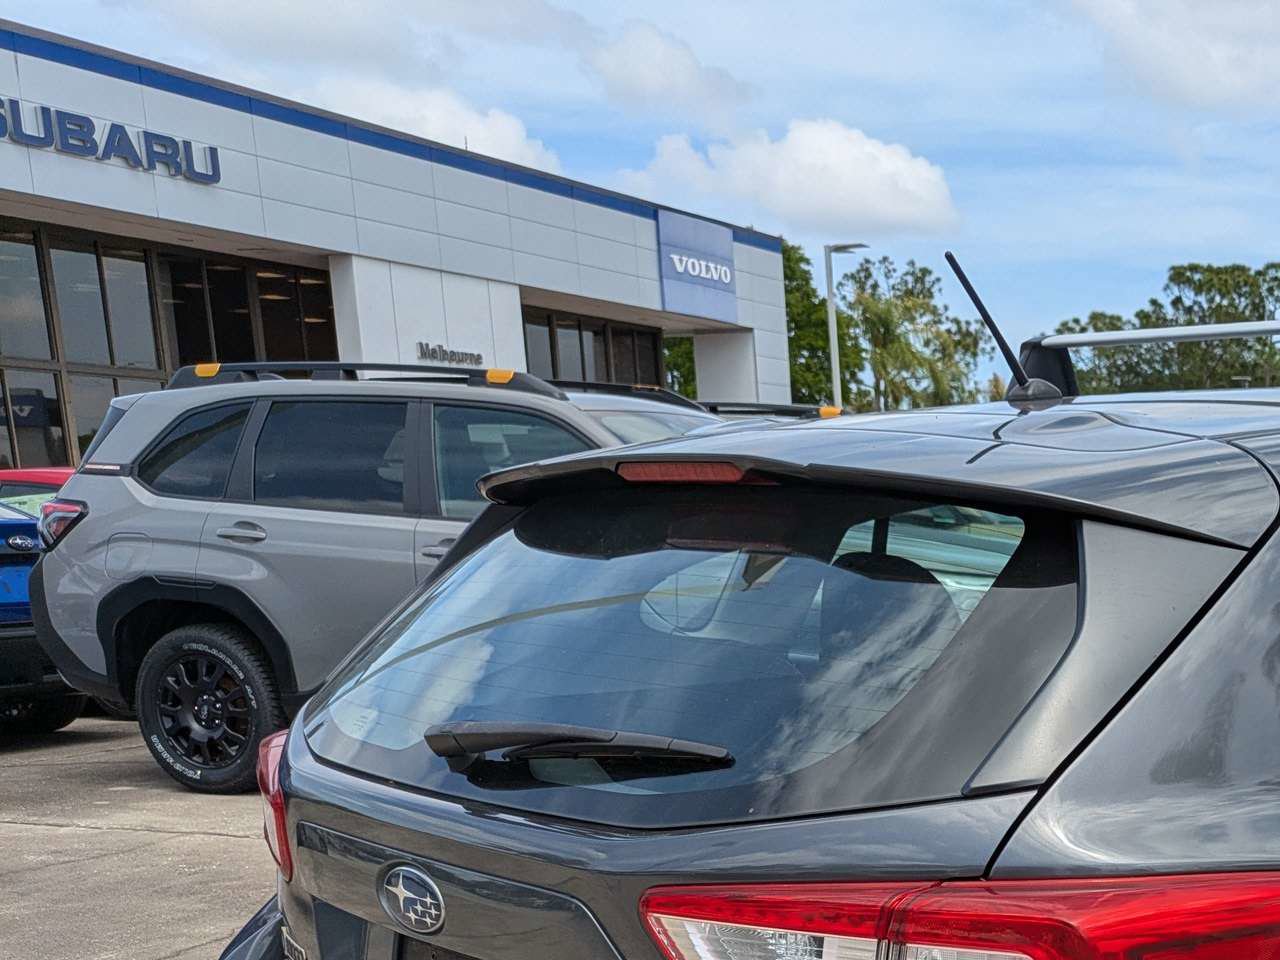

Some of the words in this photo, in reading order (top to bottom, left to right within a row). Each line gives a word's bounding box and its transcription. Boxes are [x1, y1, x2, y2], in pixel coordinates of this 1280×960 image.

[0, 97, 221, 185] UBARU
[669, 254, 731, 284] VOLVO
[416, 341, 483, 366] Melbourne
